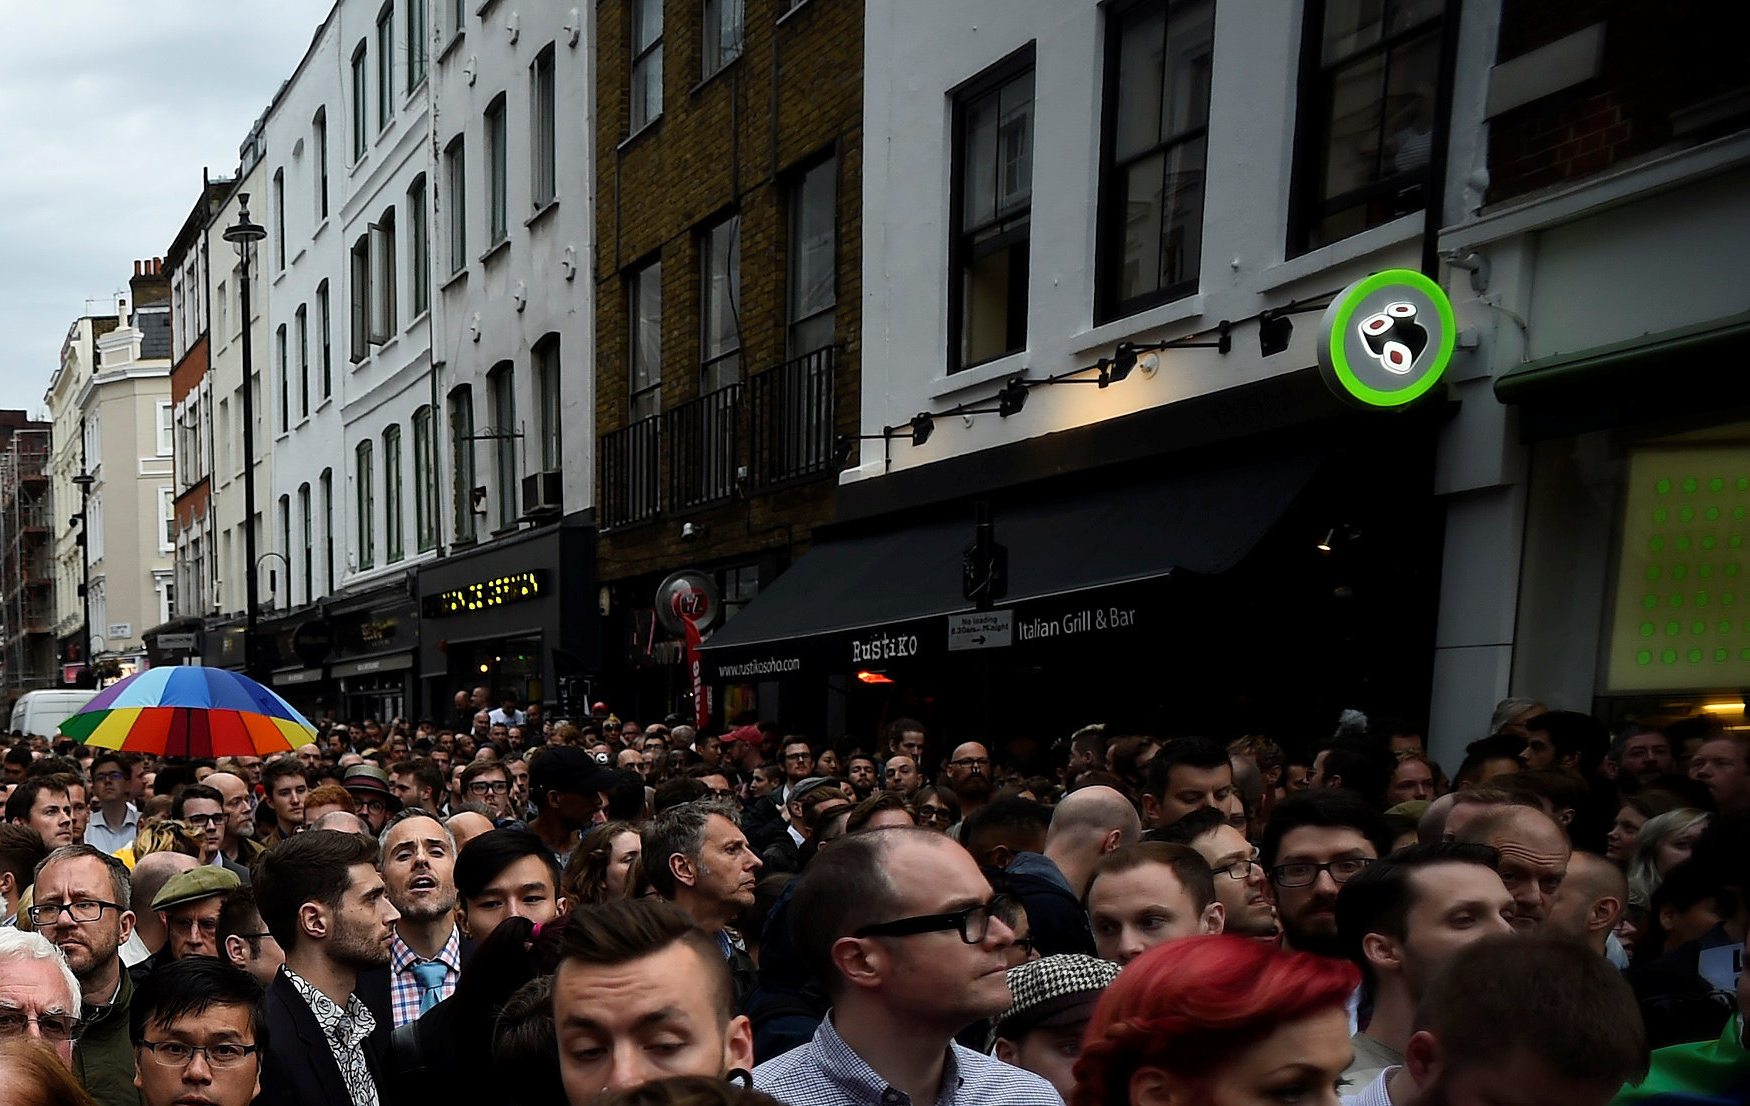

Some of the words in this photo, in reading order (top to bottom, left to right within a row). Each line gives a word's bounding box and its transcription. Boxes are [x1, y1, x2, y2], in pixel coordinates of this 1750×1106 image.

[1019, 617, 1060, 641] Italian
[1063, 610, 1091, 634] Grill
[1096, 608, 1108, 630] &
[1110, 606, 1136, 628] Bar
[718, 656, 800, 677] www.rustikosoho.com
